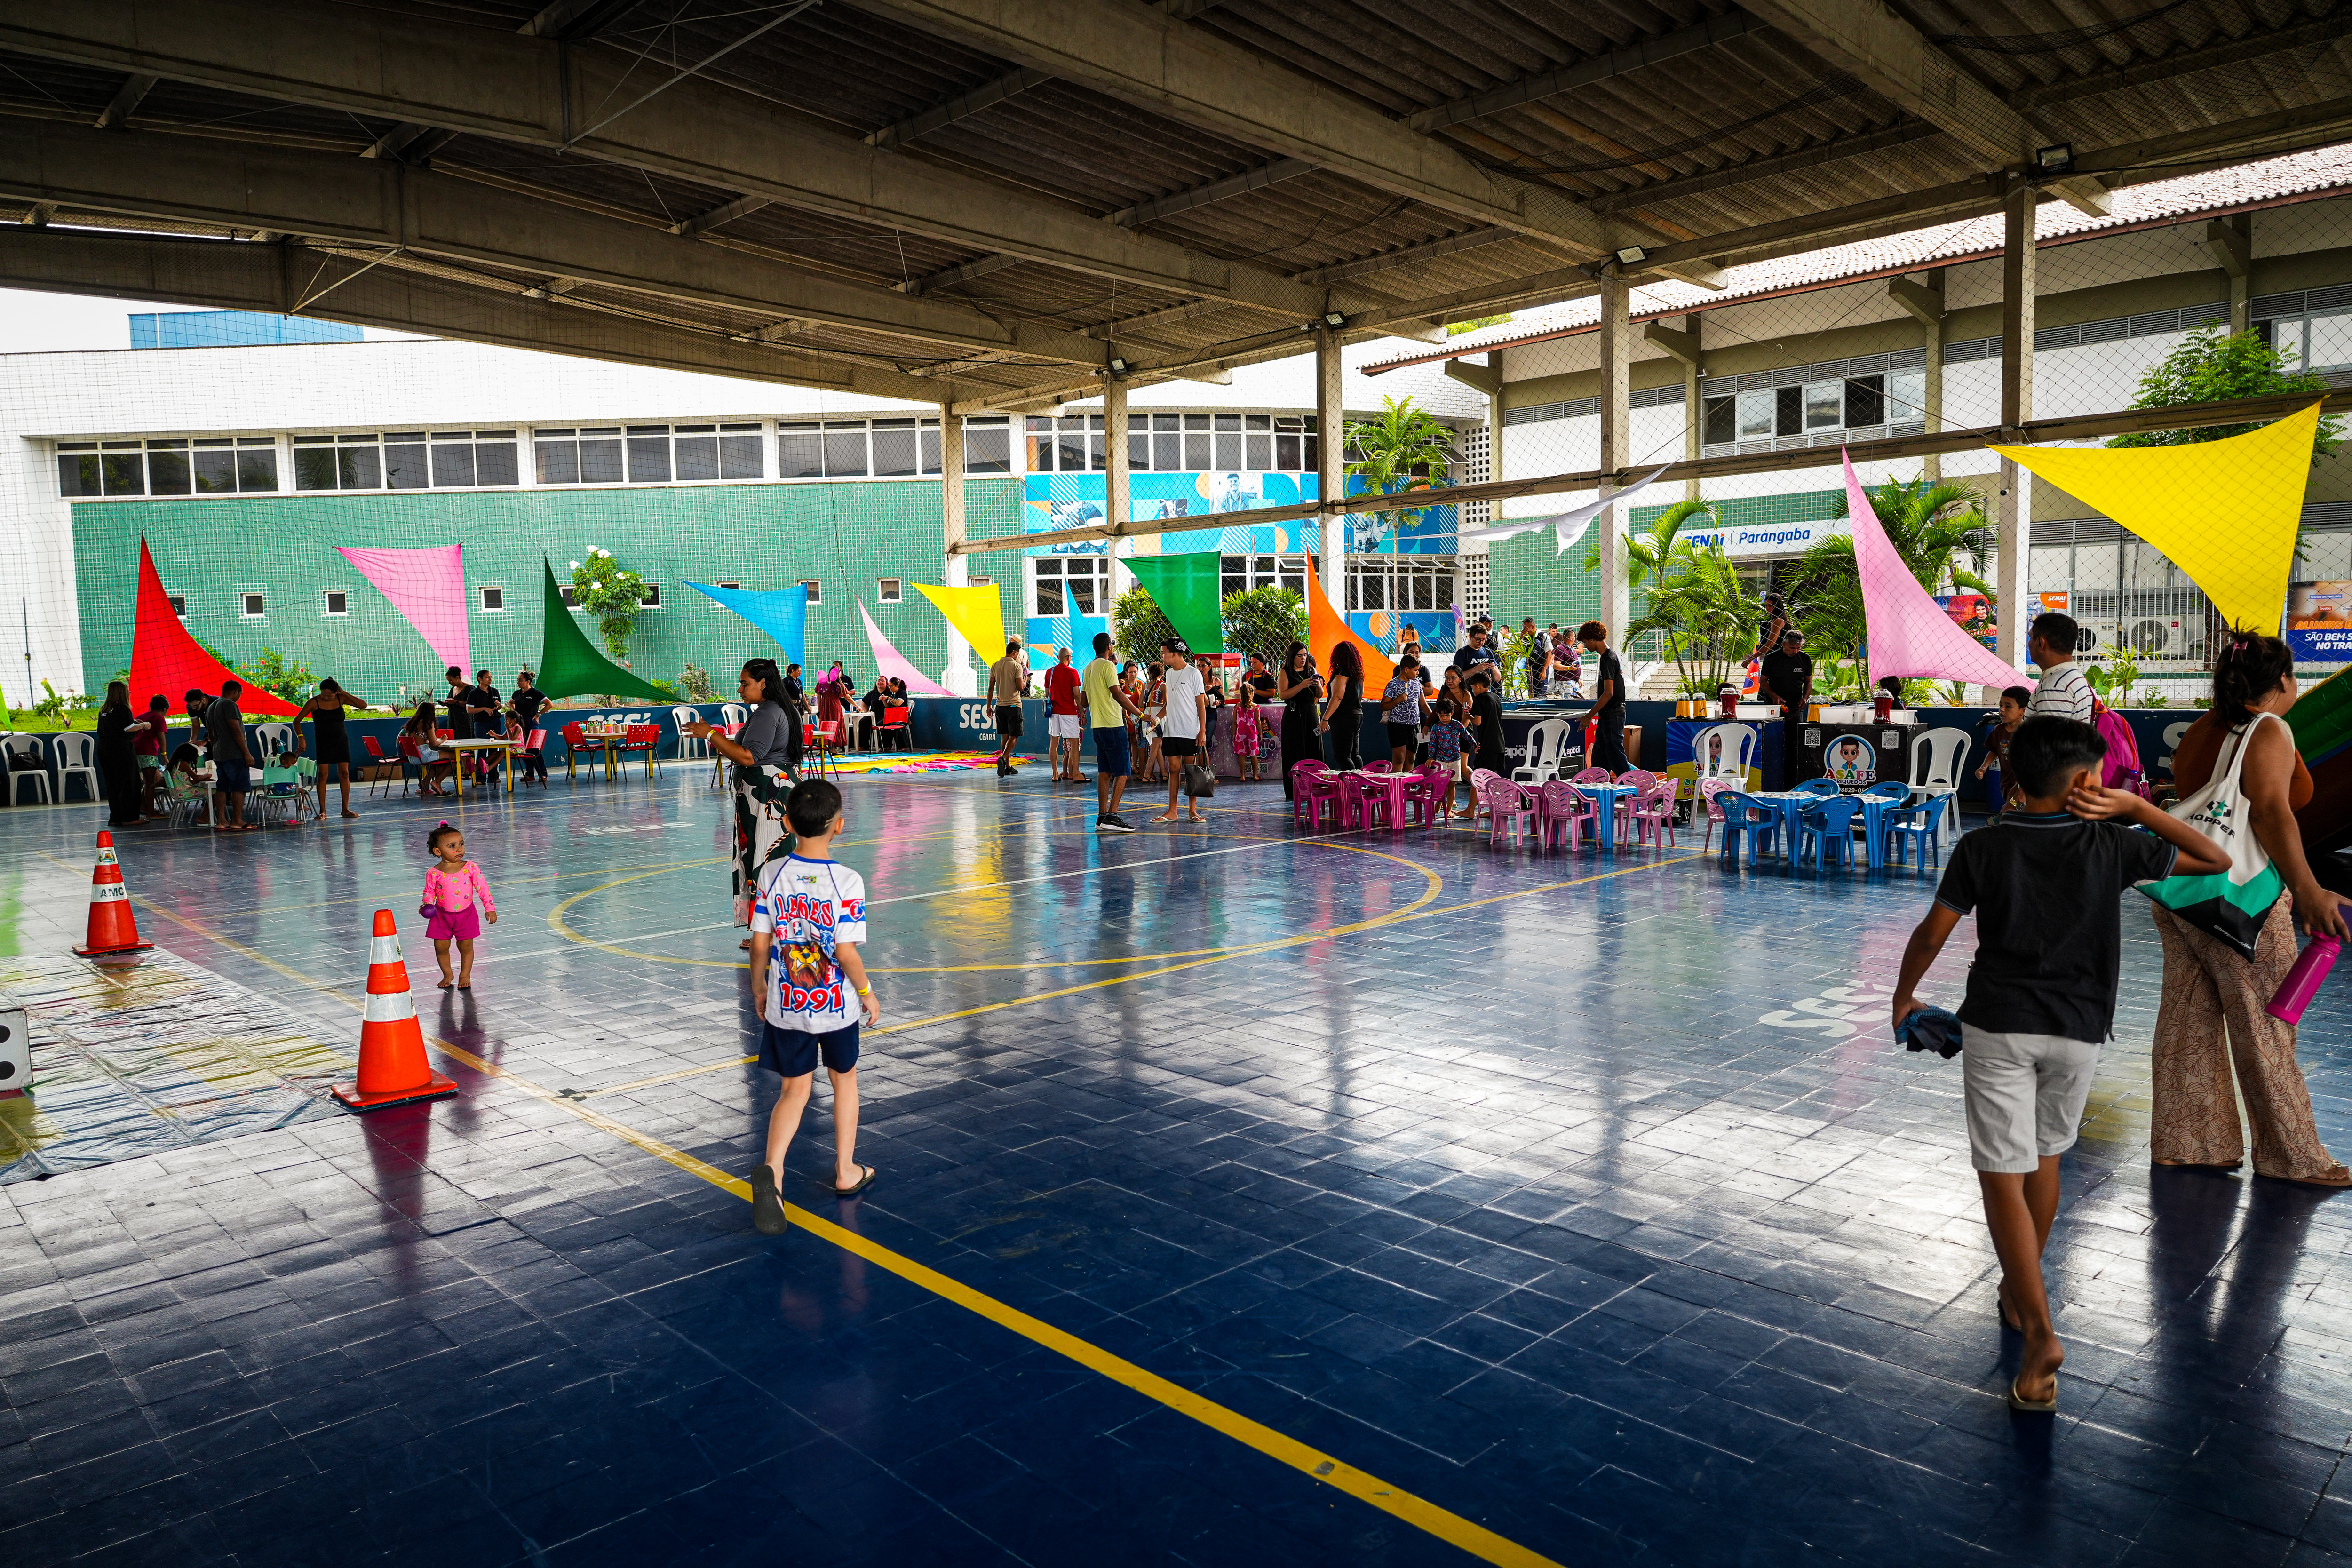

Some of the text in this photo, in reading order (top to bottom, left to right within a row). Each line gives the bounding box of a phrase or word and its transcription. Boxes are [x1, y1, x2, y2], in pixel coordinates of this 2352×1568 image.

[1739, 528, 1810, 544] Parangaba
[2295, 621, 2343, 630] ALUNOS
[2305, 632, 2323, 641] SÃO
[979, 732, 996, 740] CEARÁ
[1825, 769, 1875, 780] ASAFE
[100, 887, 124, 898] AMC
[780, 982, 843, 1011] 1991
